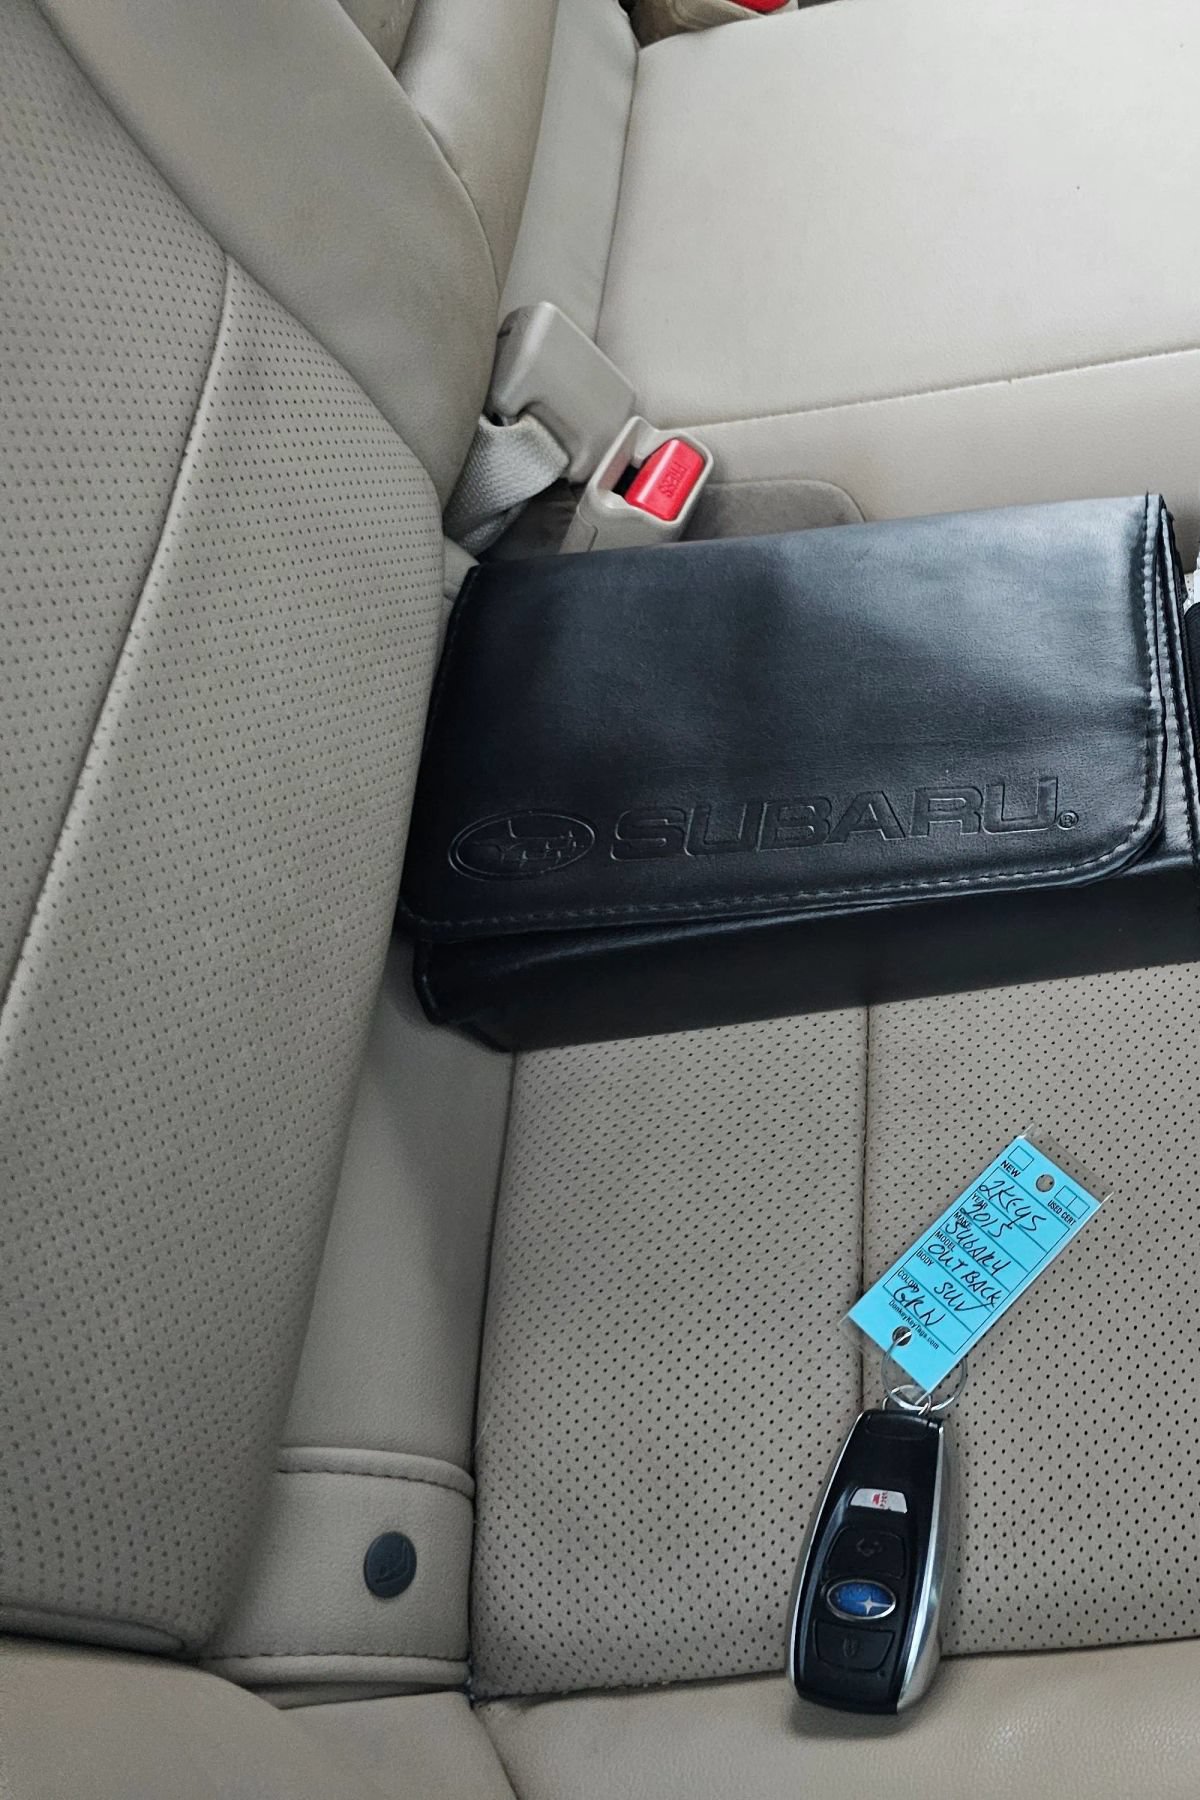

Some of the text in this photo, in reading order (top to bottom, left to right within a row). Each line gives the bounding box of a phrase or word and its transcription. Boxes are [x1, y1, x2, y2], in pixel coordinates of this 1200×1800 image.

[658, 461, 688, 498] PRESS
[1000, 1160, 1021, 1178] NEW
[971, 1193, 988, 1210] YEAR
[1047, 1199, 1077, 1226] USED CERT
[960, 1203, 1012, 1237] 2015
[934, 1230, 956, 1252] MODEL
[916, 1250, 934, 1266] BODY
[934, 1282, 994, 1311] SUV
